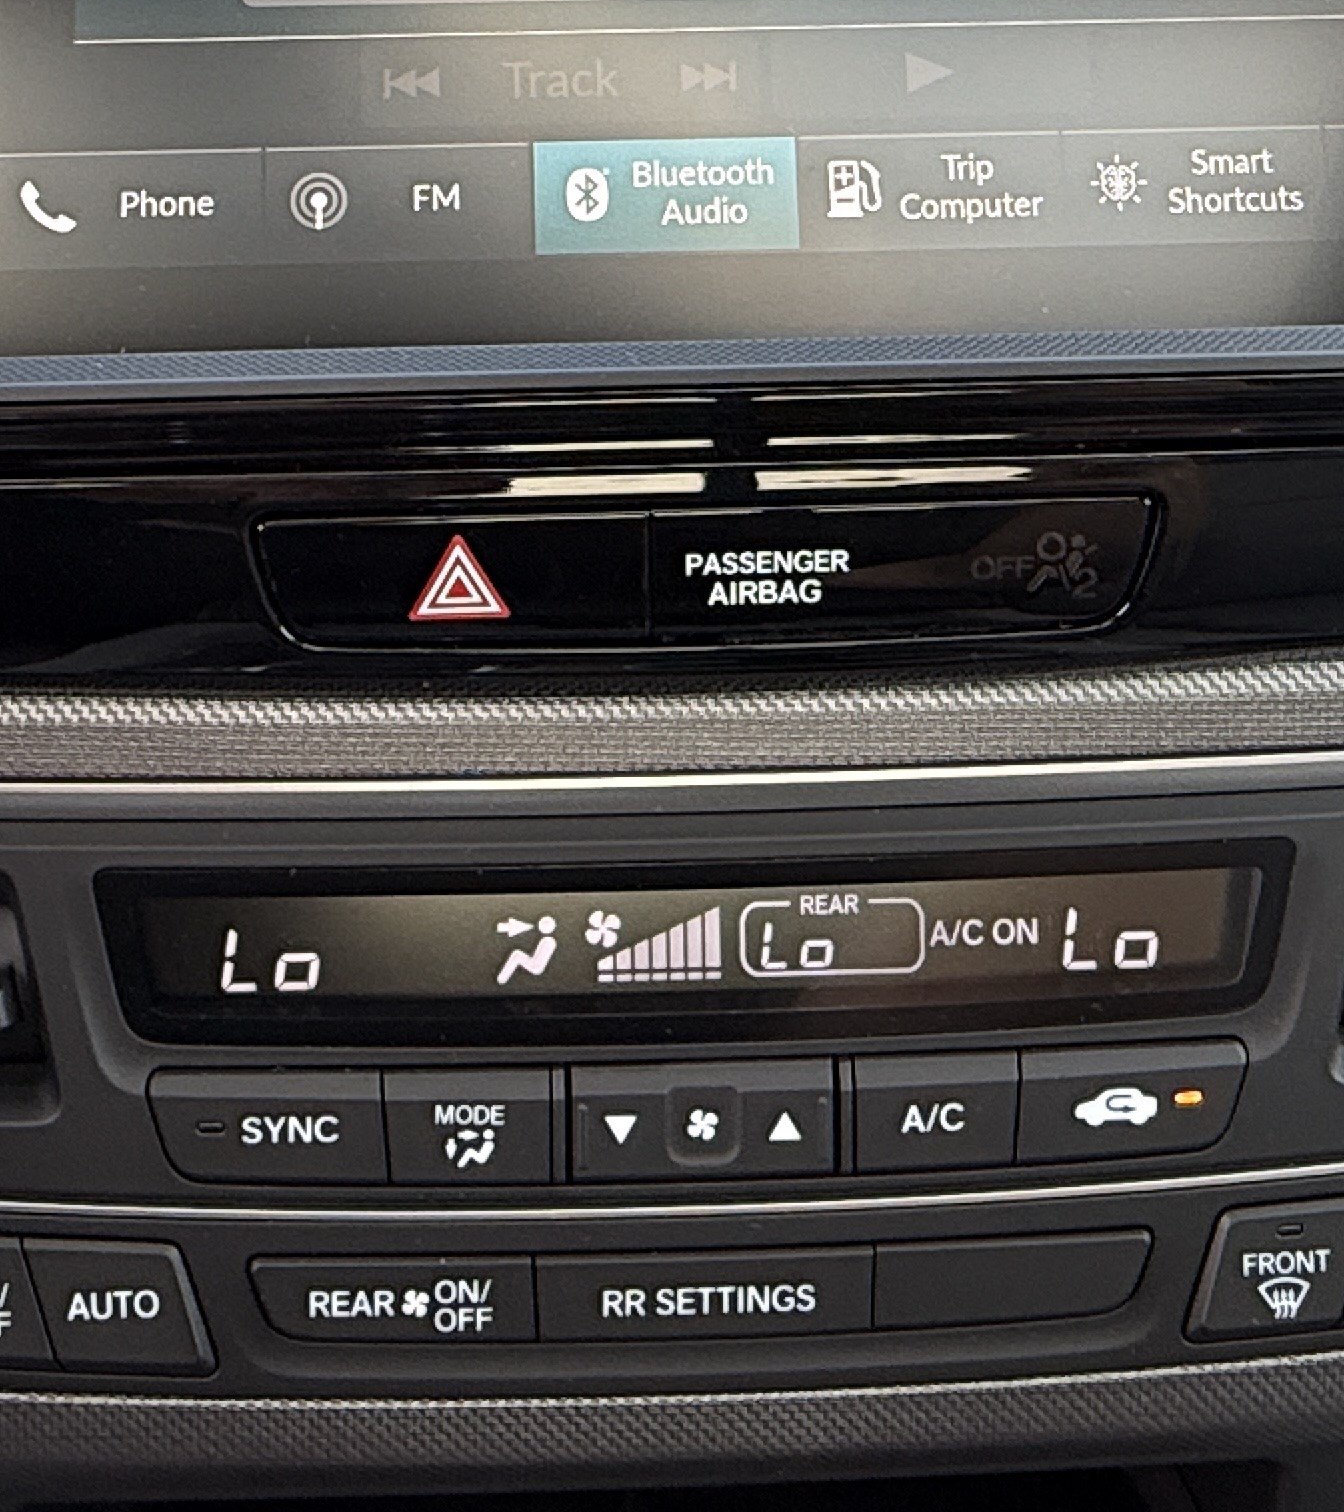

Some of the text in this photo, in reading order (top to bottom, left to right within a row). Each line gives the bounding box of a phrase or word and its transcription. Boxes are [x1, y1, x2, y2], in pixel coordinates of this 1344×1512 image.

[501, 57, 618, 98] Track
[633, 157, 774, 187] Bluetooth
[941, 153, 993, 185] Trip
[1191, 149, 1273, 175] Smart
[121, 189, 214, 217] Phone
[413, 183, 459, 211] FM
[661, 195, 747, 225] Audio
[901, 193, 1043, 224] Computer
[1169, 186, 1303, 213] Shortcuts
[685, 549, 849, 576] PASSENGER
[708, 579, 821, 605] AIRBAG
[801, 894, 859, 915] REAR
[930, 918, 1038, 947] A/C ON
[435, 1105, 505, 1125] MODE
[901, 1103, 963, 1133] A/C
[242, 1116, 339, 1143] SYNC
[1243, 1249, 1330, 1277] FRONT
[309, 1291, 394, 1317] REAR
[435, 1279, 491, 1303] ON/
[603, 1285, 815, 1317] RR SETTINGS
[68, 1290, 159, 1321] AUTO
[435, 1307, 493, 1332] OFF
